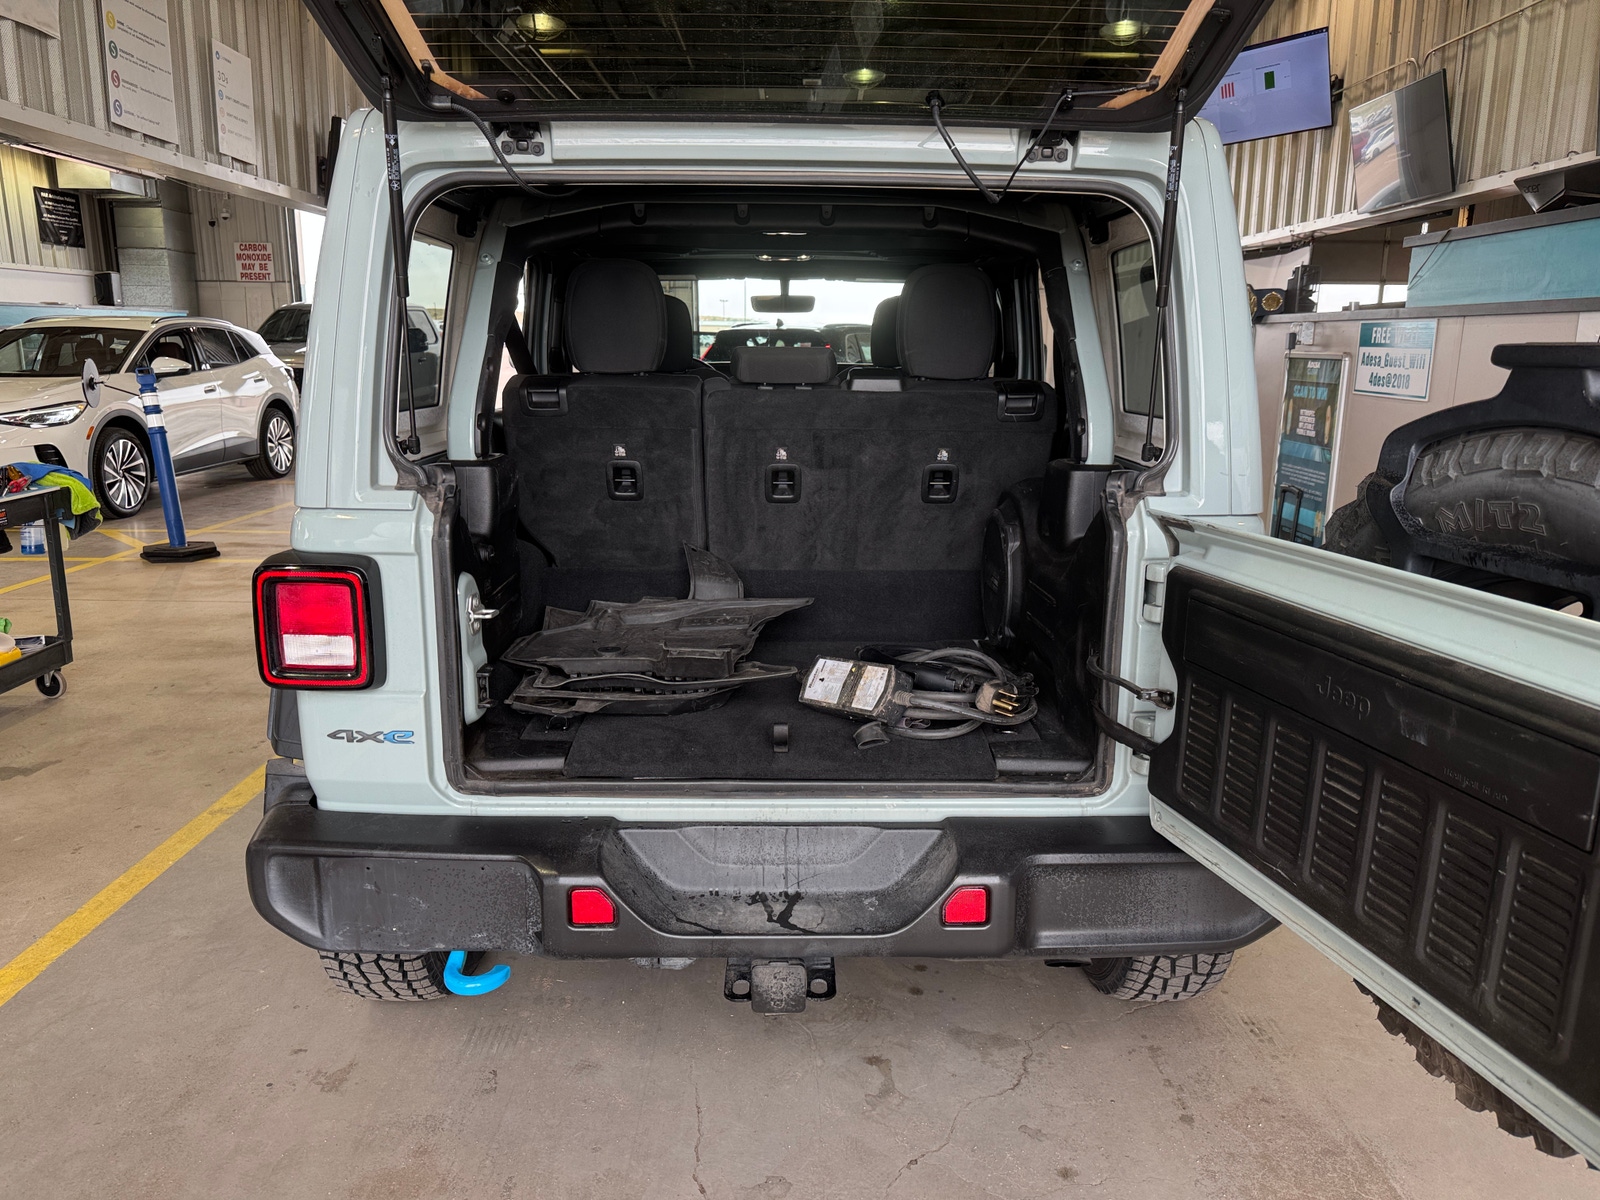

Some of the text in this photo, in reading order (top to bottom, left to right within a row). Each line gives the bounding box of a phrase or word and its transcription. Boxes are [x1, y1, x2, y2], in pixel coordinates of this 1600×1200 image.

[1523, 183, 1541, 194] acer
[239, 243, 268, 252] CARBON
[236, 253, 272, 262] MONOXIDE
[241, 262, 269, 271] MAY BE
[240, 272, 271, 281] PRESENT
[1371, 326, 1392, 344] FREE
[1369, 372, 1410, 389] 4des@2018
[1315, 674, 1371, 721] Jeep
